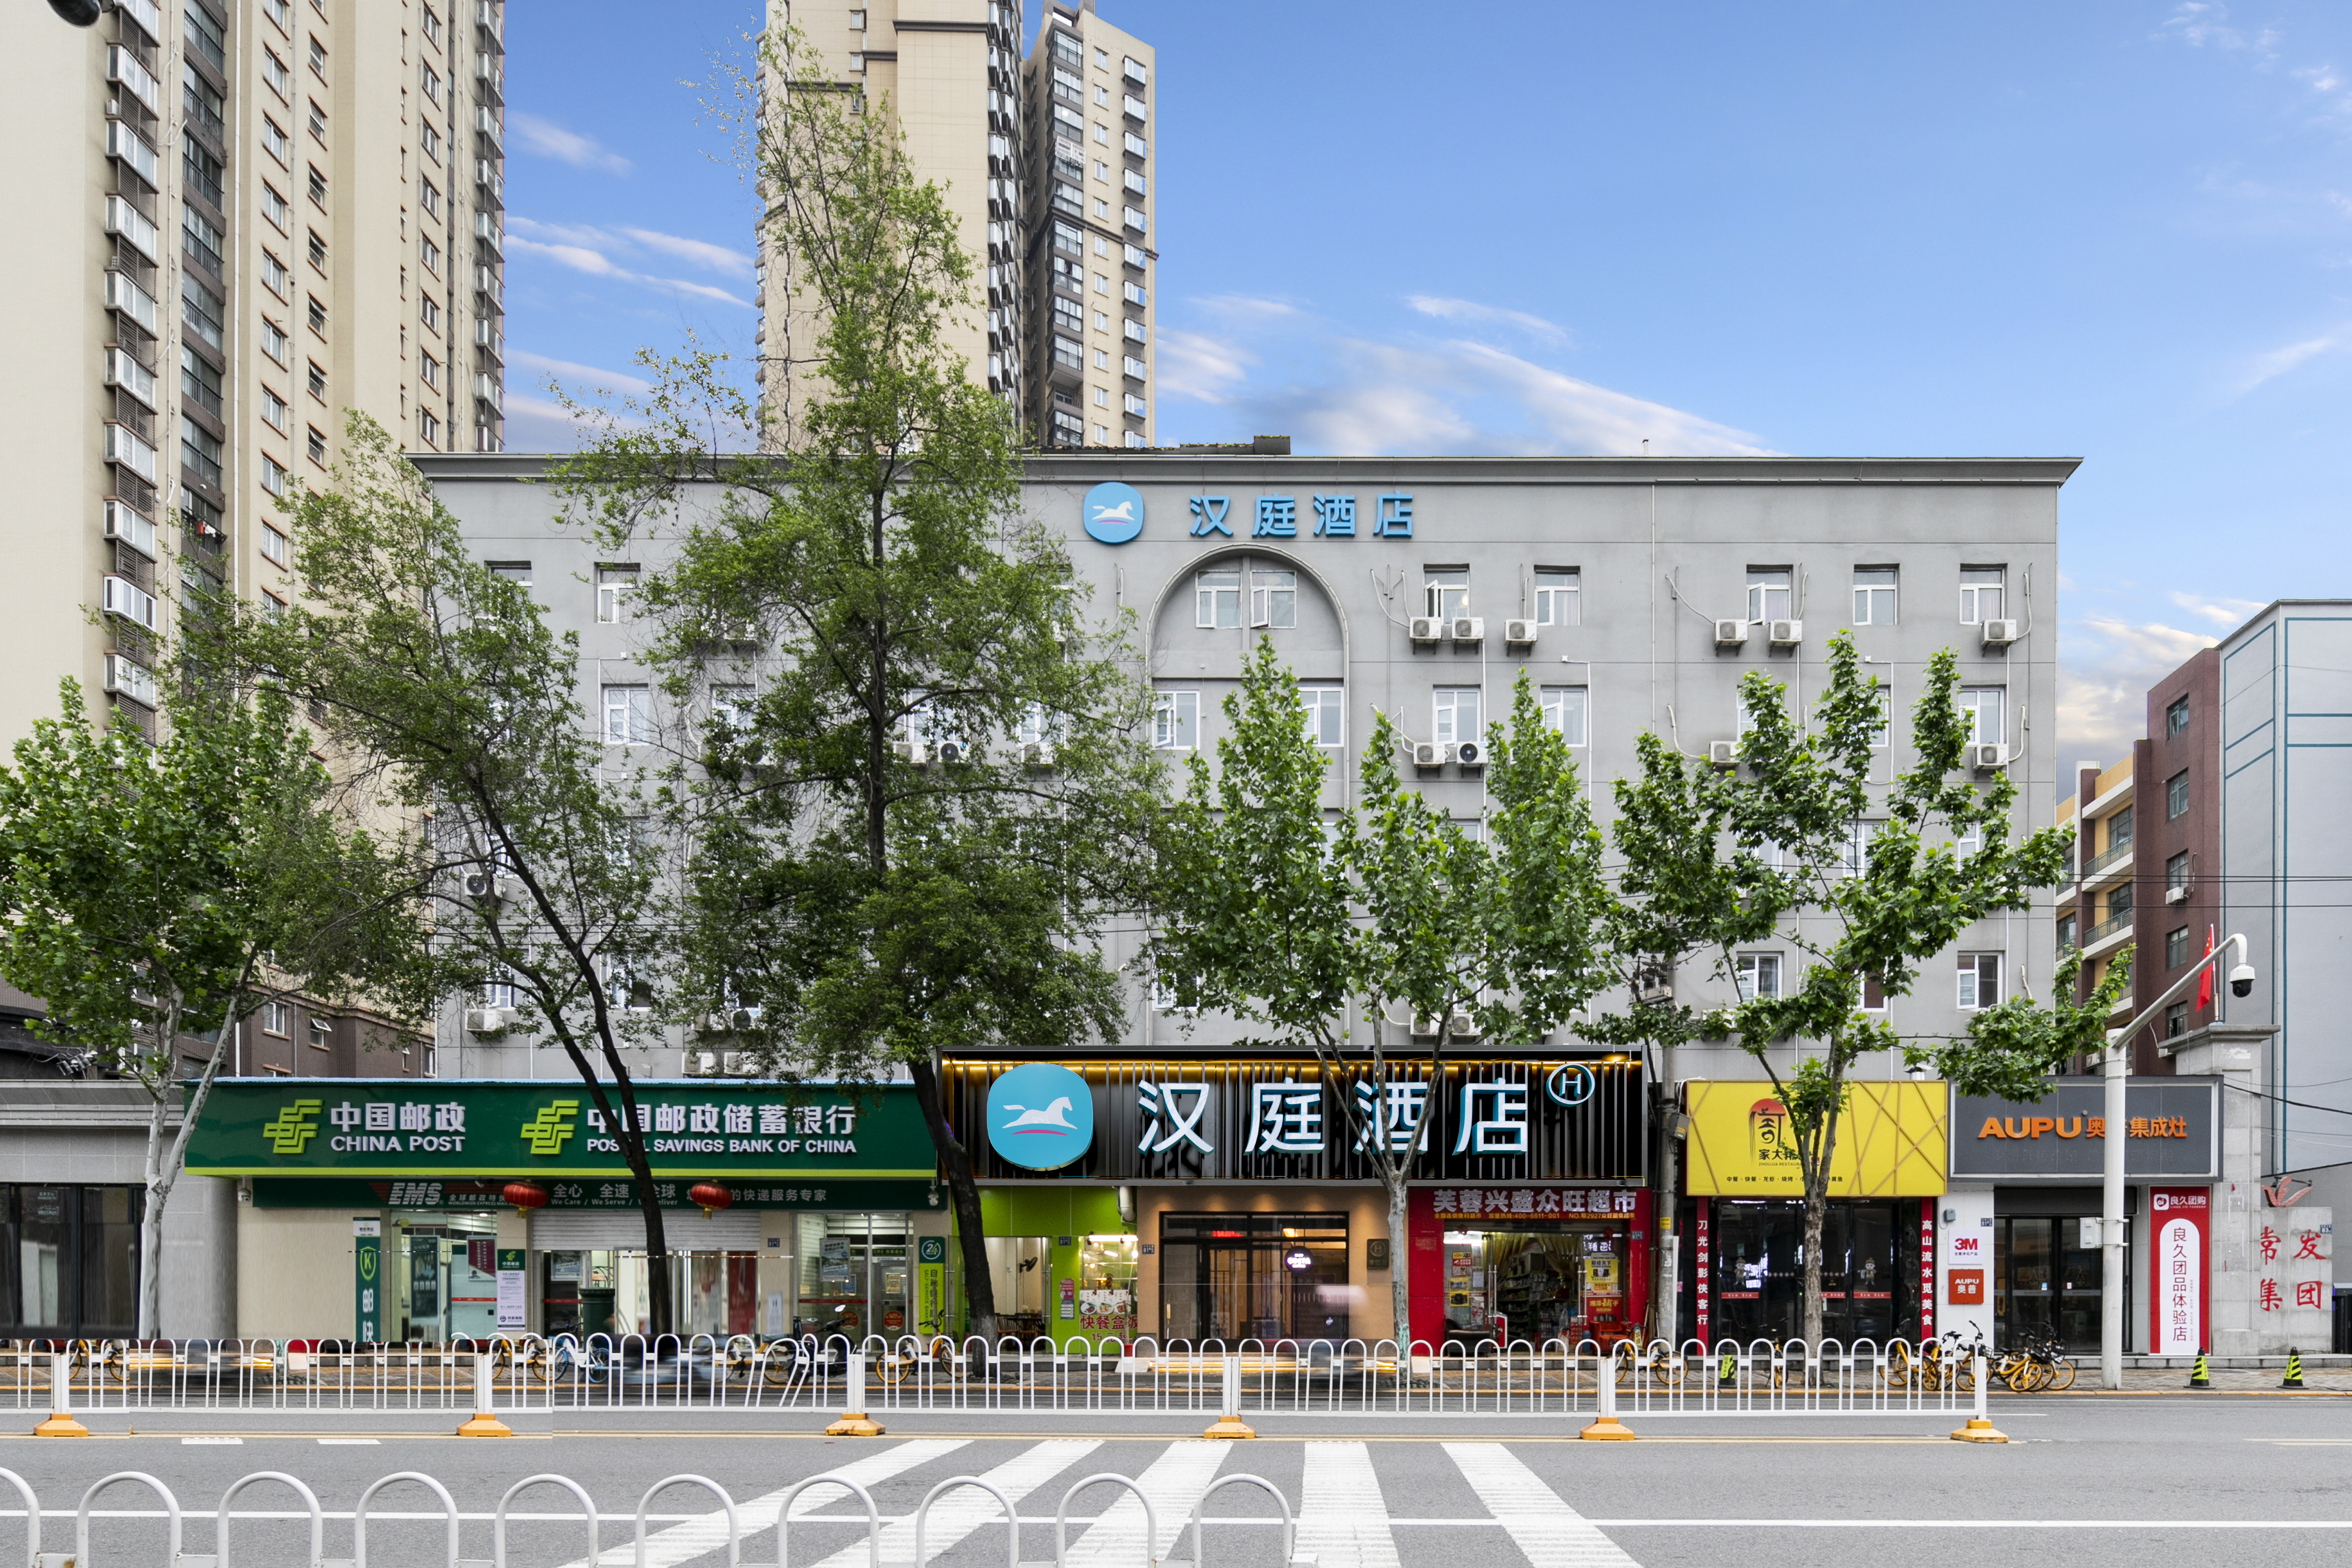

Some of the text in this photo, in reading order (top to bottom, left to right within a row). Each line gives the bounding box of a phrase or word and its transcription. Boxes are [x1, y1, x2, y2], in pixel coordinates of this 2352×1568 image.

[1190, 491, 1413, 537] 汉庭酒店
[331, 1102, 466, 1133] 中国邮政
[1138, 1076, 1528, 1155] 汉庭酒店
[1978, 1117, 2081, 1139] AUPU
[2086, 1116, 2187, 1138] 奥集成灶
[331, 1136, 465, 1152] CHINA POST
[587, 1139, 857, 1153] POSL SAVINGS BANK OF CHINA
[388, 1183, 442, 1204] EMS
[553, 1183, 582, 1197] 全心
[600, 1183, 629, 1197] 全速
[1433, 1189, 1637, 1212] 芙蓉兴盛众旺超市
[2170, 1196, 2206, 1205] 良久团购
[1954, 1238, 1978, 1250] 3M
[2261, 1226, 2327, 1265] 常发
[1697, 1220, 1708, 1325] 刀光剑影侠客行
[1922, 1220, 1932, 1326] 高山流水觅美食
[1957, 1285, 1976, 1295] 奥普
[2172, 1227, 2187, 1342] 良久团品体验店
[2261, 1278, 2323, 1311] 集团
